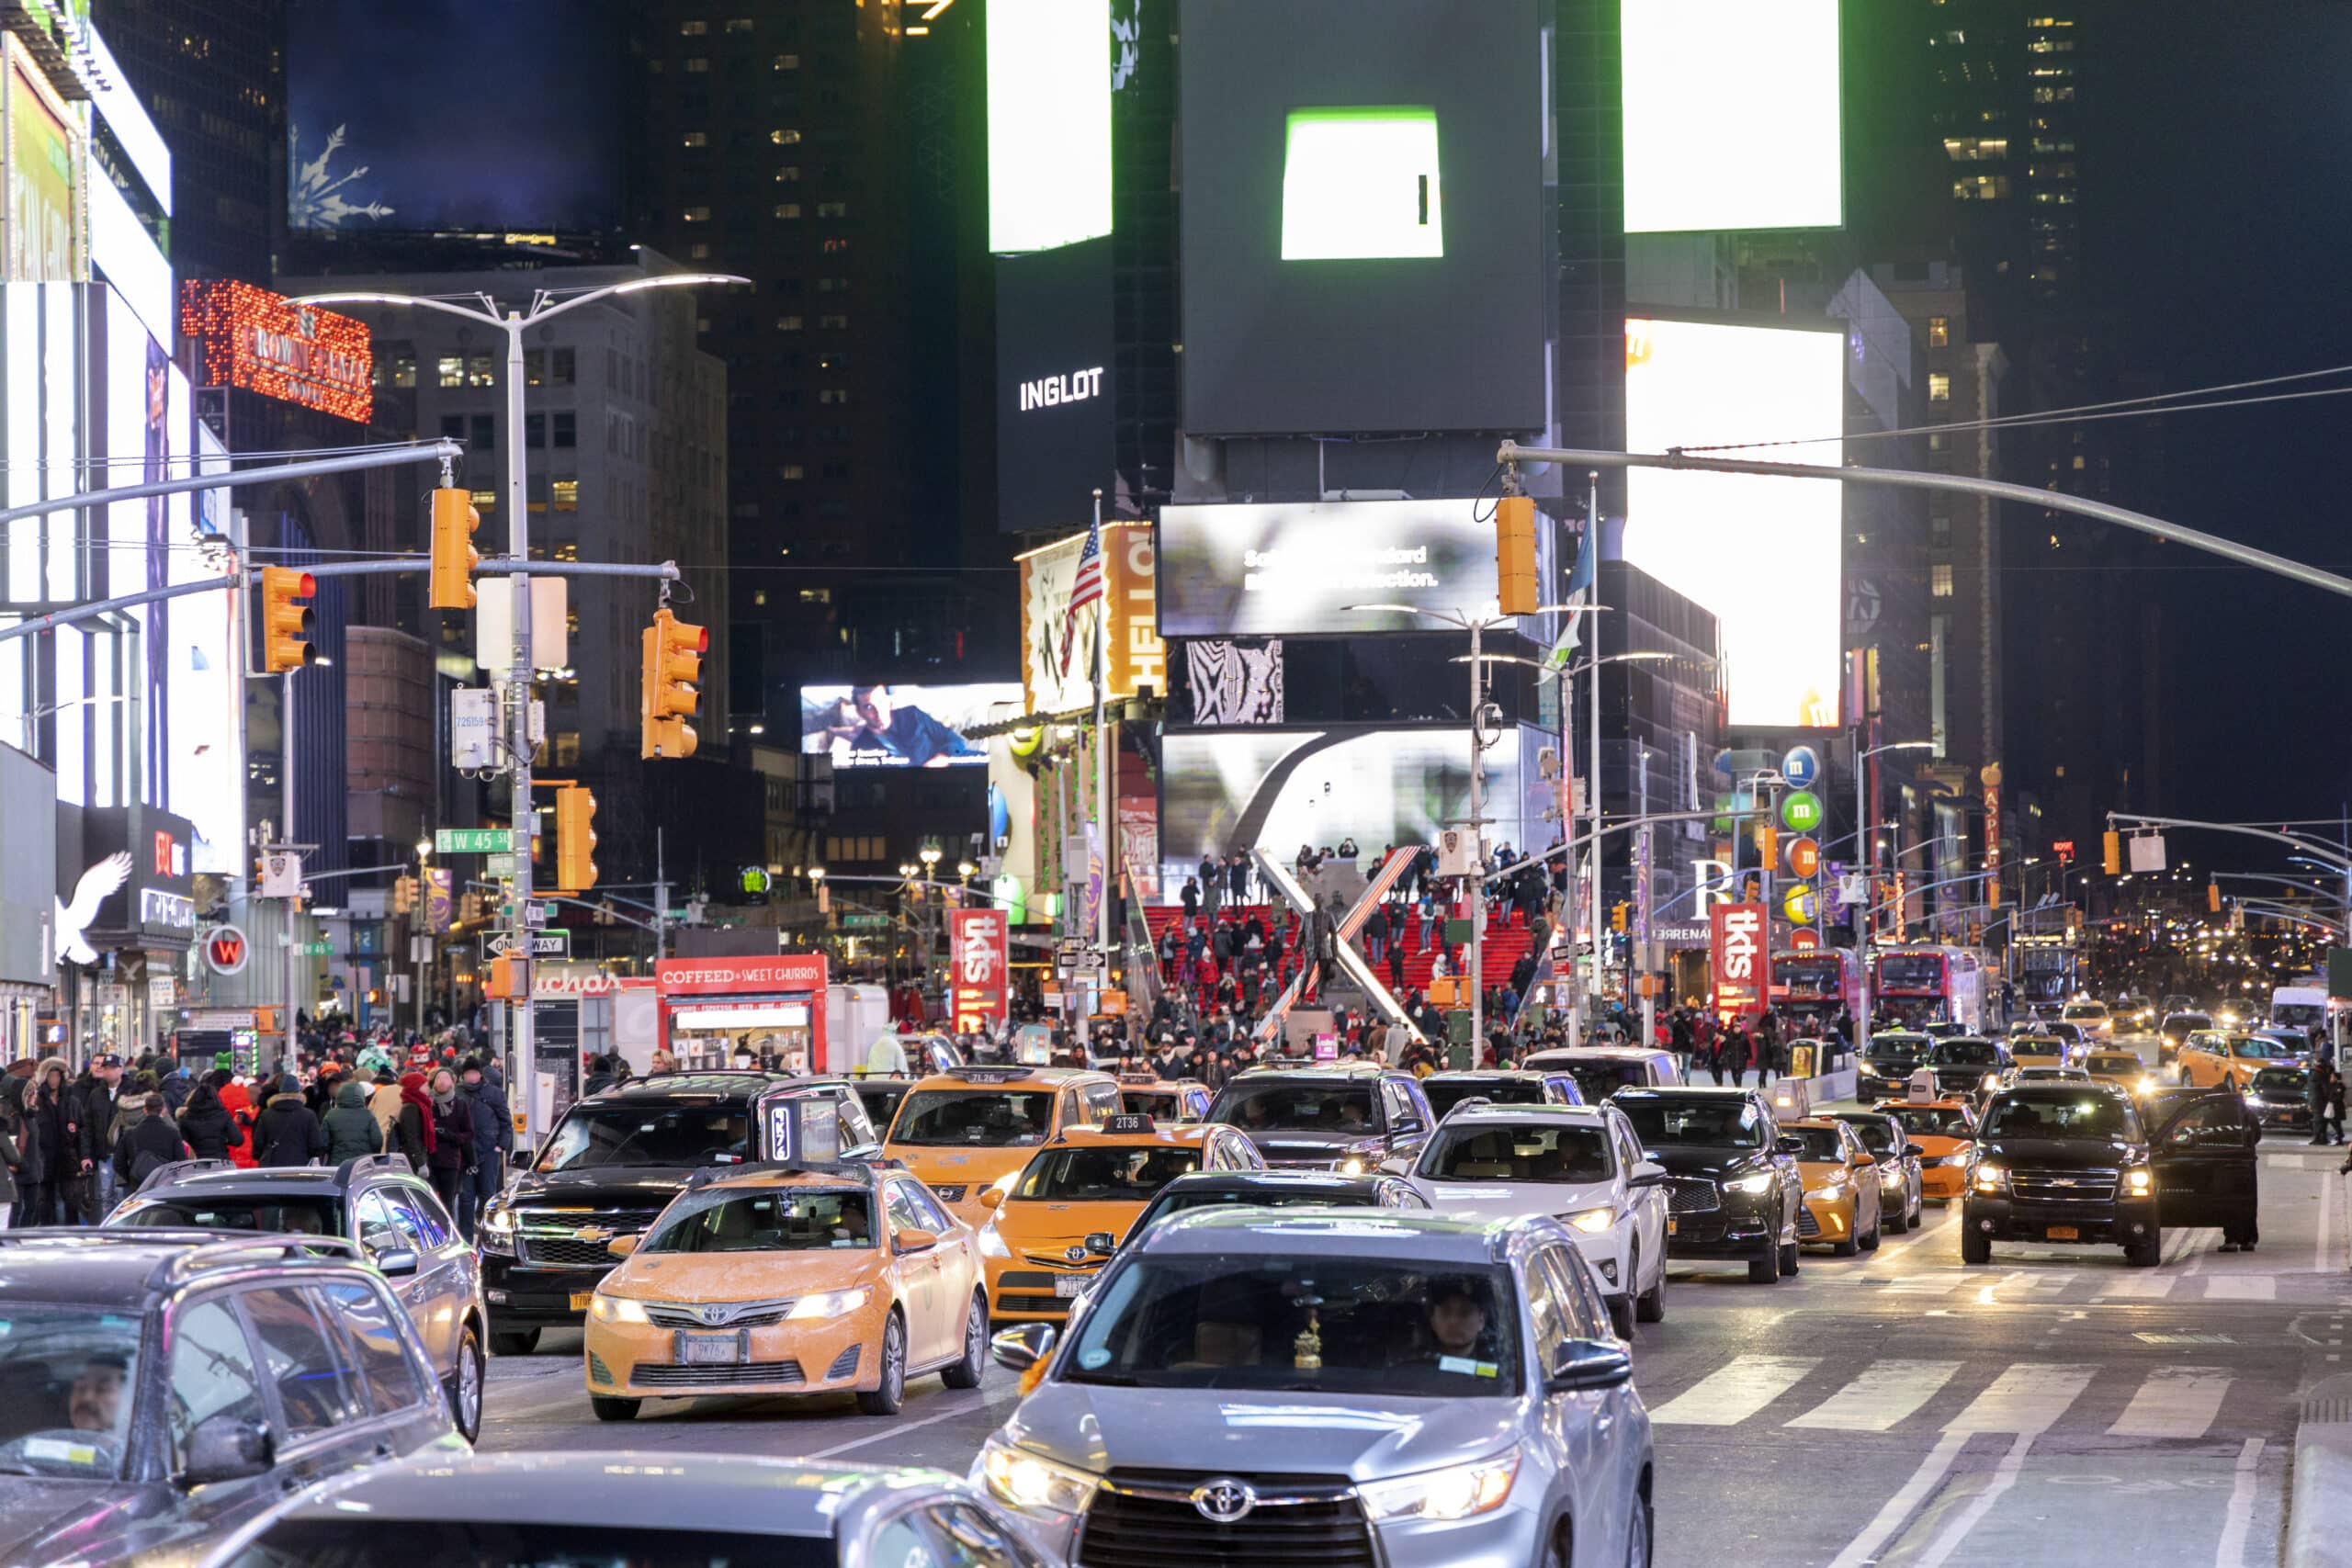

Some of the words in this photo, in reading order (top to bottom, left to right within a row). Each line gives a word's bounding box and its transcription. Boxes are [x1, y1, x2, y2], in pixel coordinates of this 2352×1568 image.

[1020, 367, 1103, 411] INGLOT
[1792, 804, 1810, 818] m
[455, 832, 467, 849] W
[475, 831, 492, 849] 45
[1802, 851, 1815, 864] m
[1690, 859, 1734, 920] R
[217, 940, 242, 964] W
[496, 940, 513, 951] ON
[532, 939, 558, 950] WAY
[965, 917, 999, 983] tkts
[1724, 909, 1758, 979] tkts
[662, 969, 734, 985] COFFEED
[741, 967, 772, 982] SWEET
[775, 966, 819, 981] CHURROS
[775, 1109, 786, 1158] 9K76
[1116, 1117, 1138, 1129] 2T36
